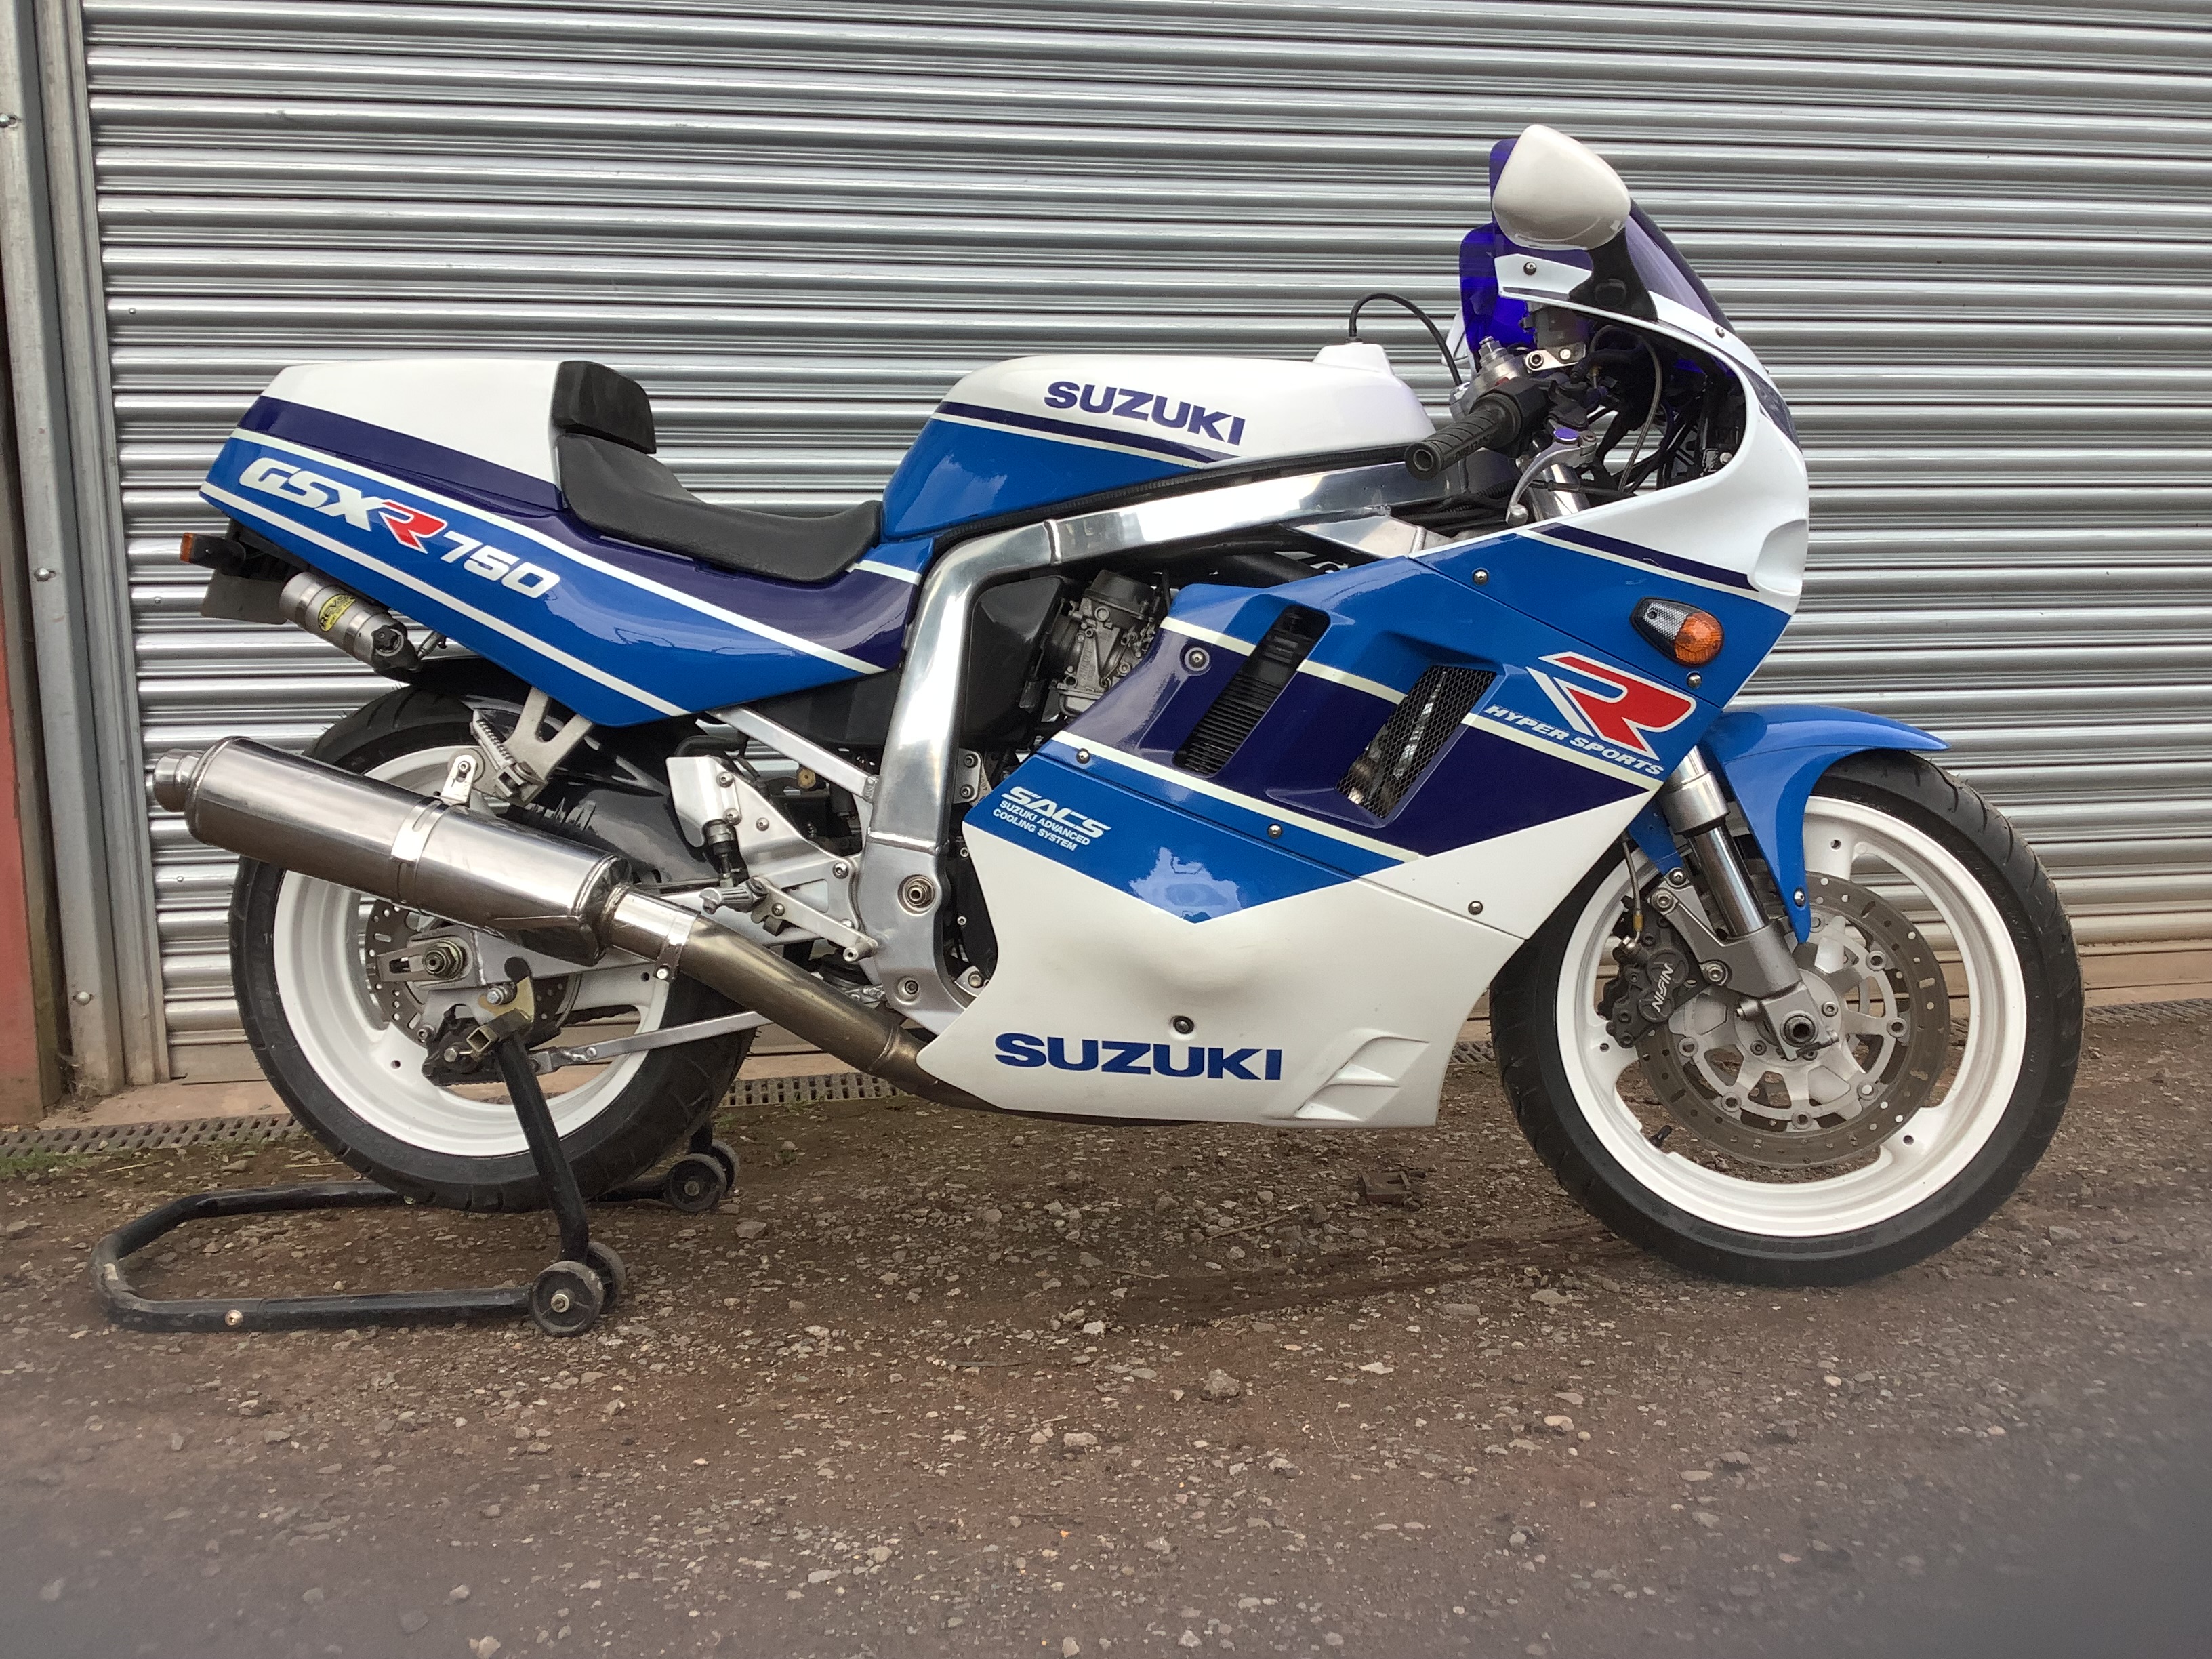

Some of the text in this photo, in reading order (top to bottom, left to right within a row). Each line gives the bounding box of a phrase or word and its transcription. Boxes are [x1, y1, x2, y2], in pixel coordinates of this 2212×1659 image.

[1044, 381, 1246, 446] SUZUKI
[440, 530, 561, 598] 750
[1525, 651, 1696, 761] R
[1483, 704, 1664, 775] HYPER SPORTS
[993, 808, 1078, 852] COOLING SYSTEM
[1000, 800, 1091, 846] SUZUKI ADVANCED
[1001, 786, 1112, 838] SACS
[1652, 962, 1674, 1013] NISSIN
[994, 1033, 1282, 1081] SUZUKI
